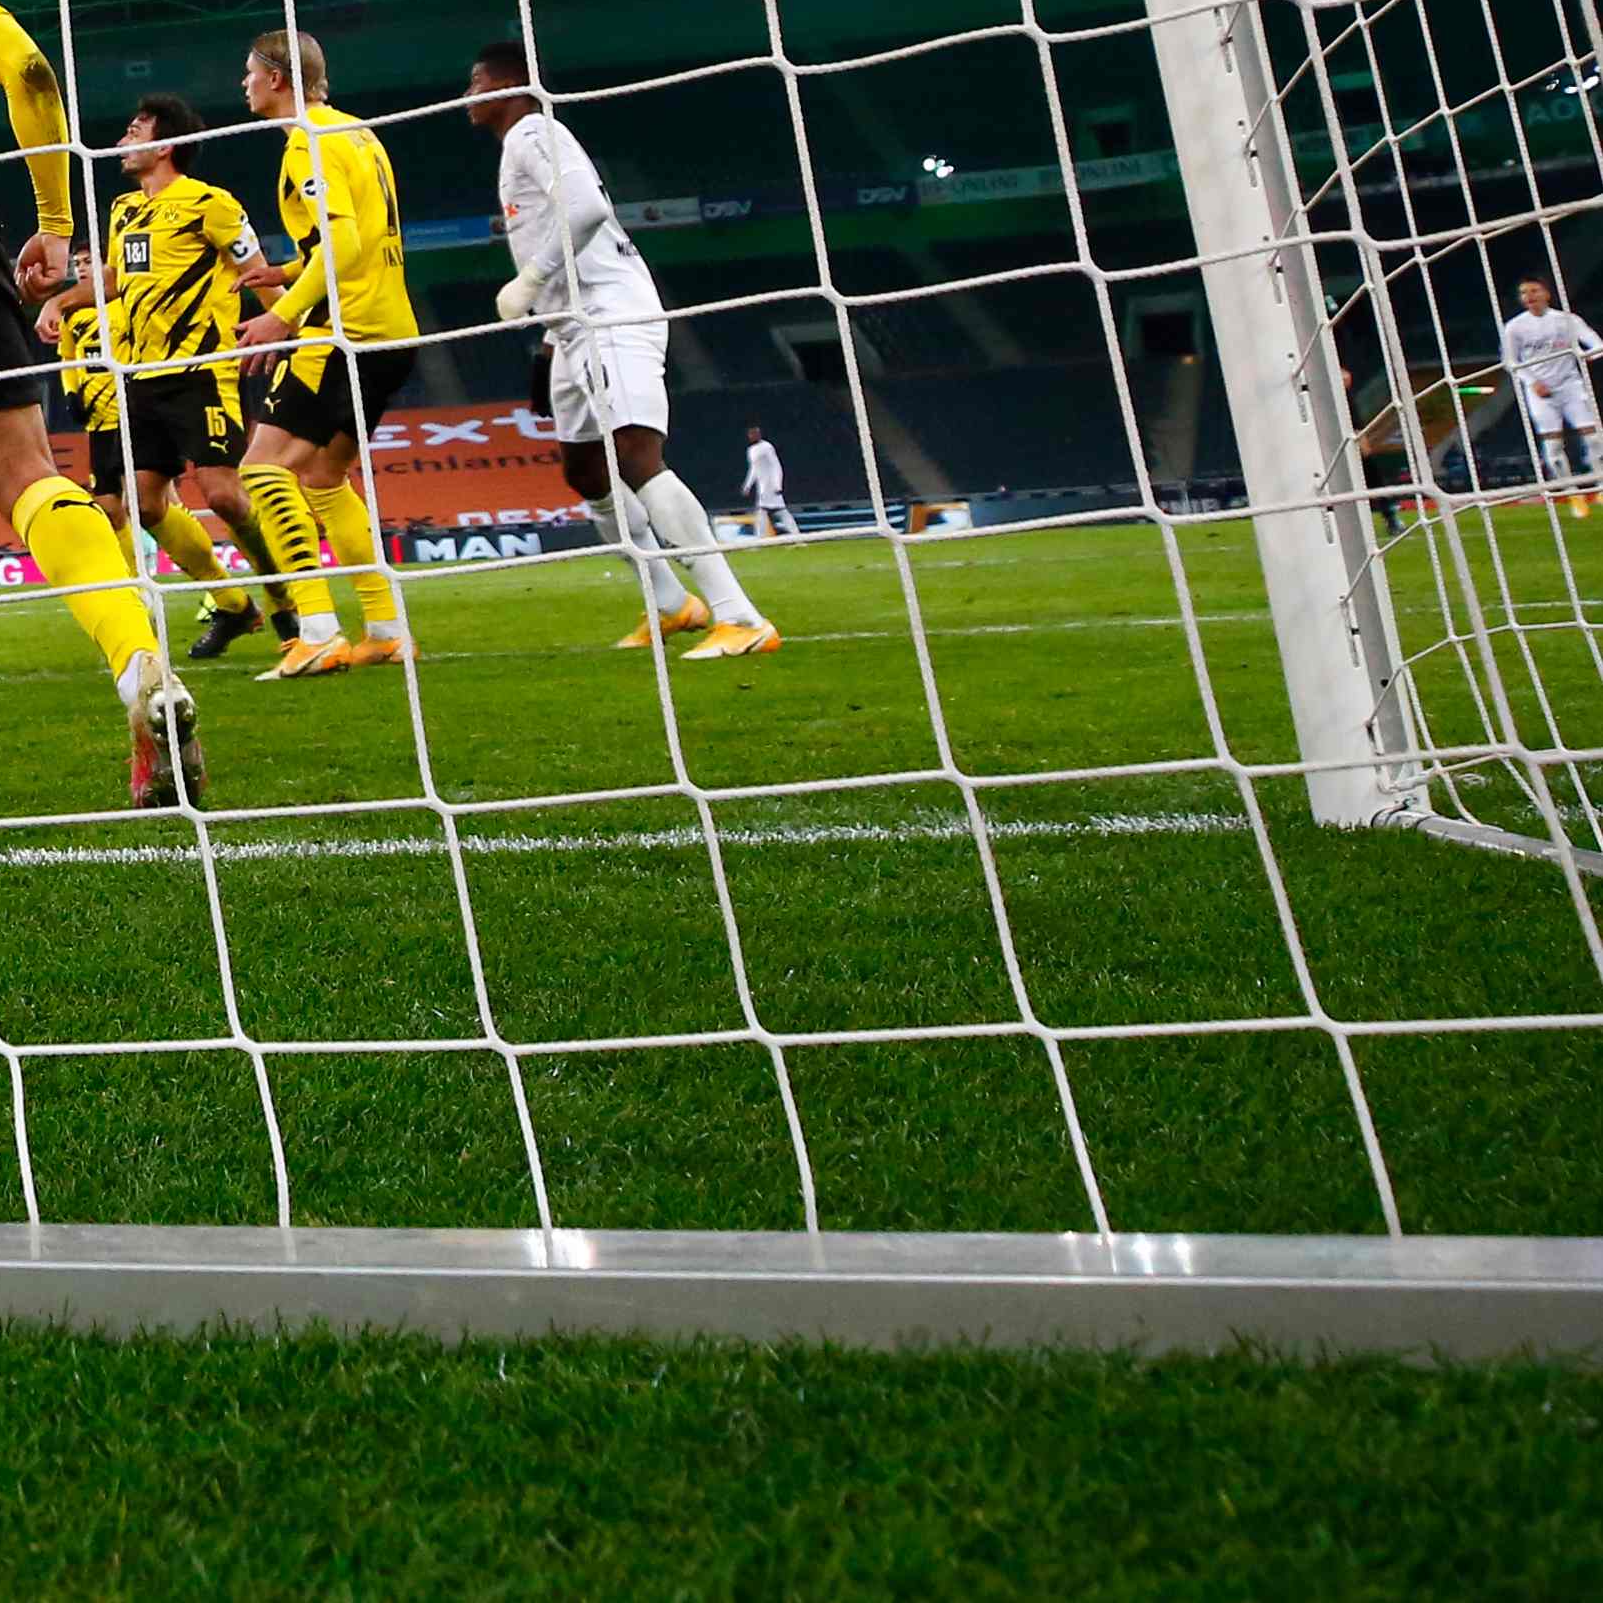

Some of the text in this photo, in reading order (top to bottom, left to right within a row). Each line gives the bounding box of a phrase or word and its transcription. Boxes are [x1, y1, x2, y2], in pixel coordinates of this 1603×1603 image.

[124, 241, 148, 263] 1&1
[204, 405, 227, 437] 15
[413, 532, 542, 563] MAN
